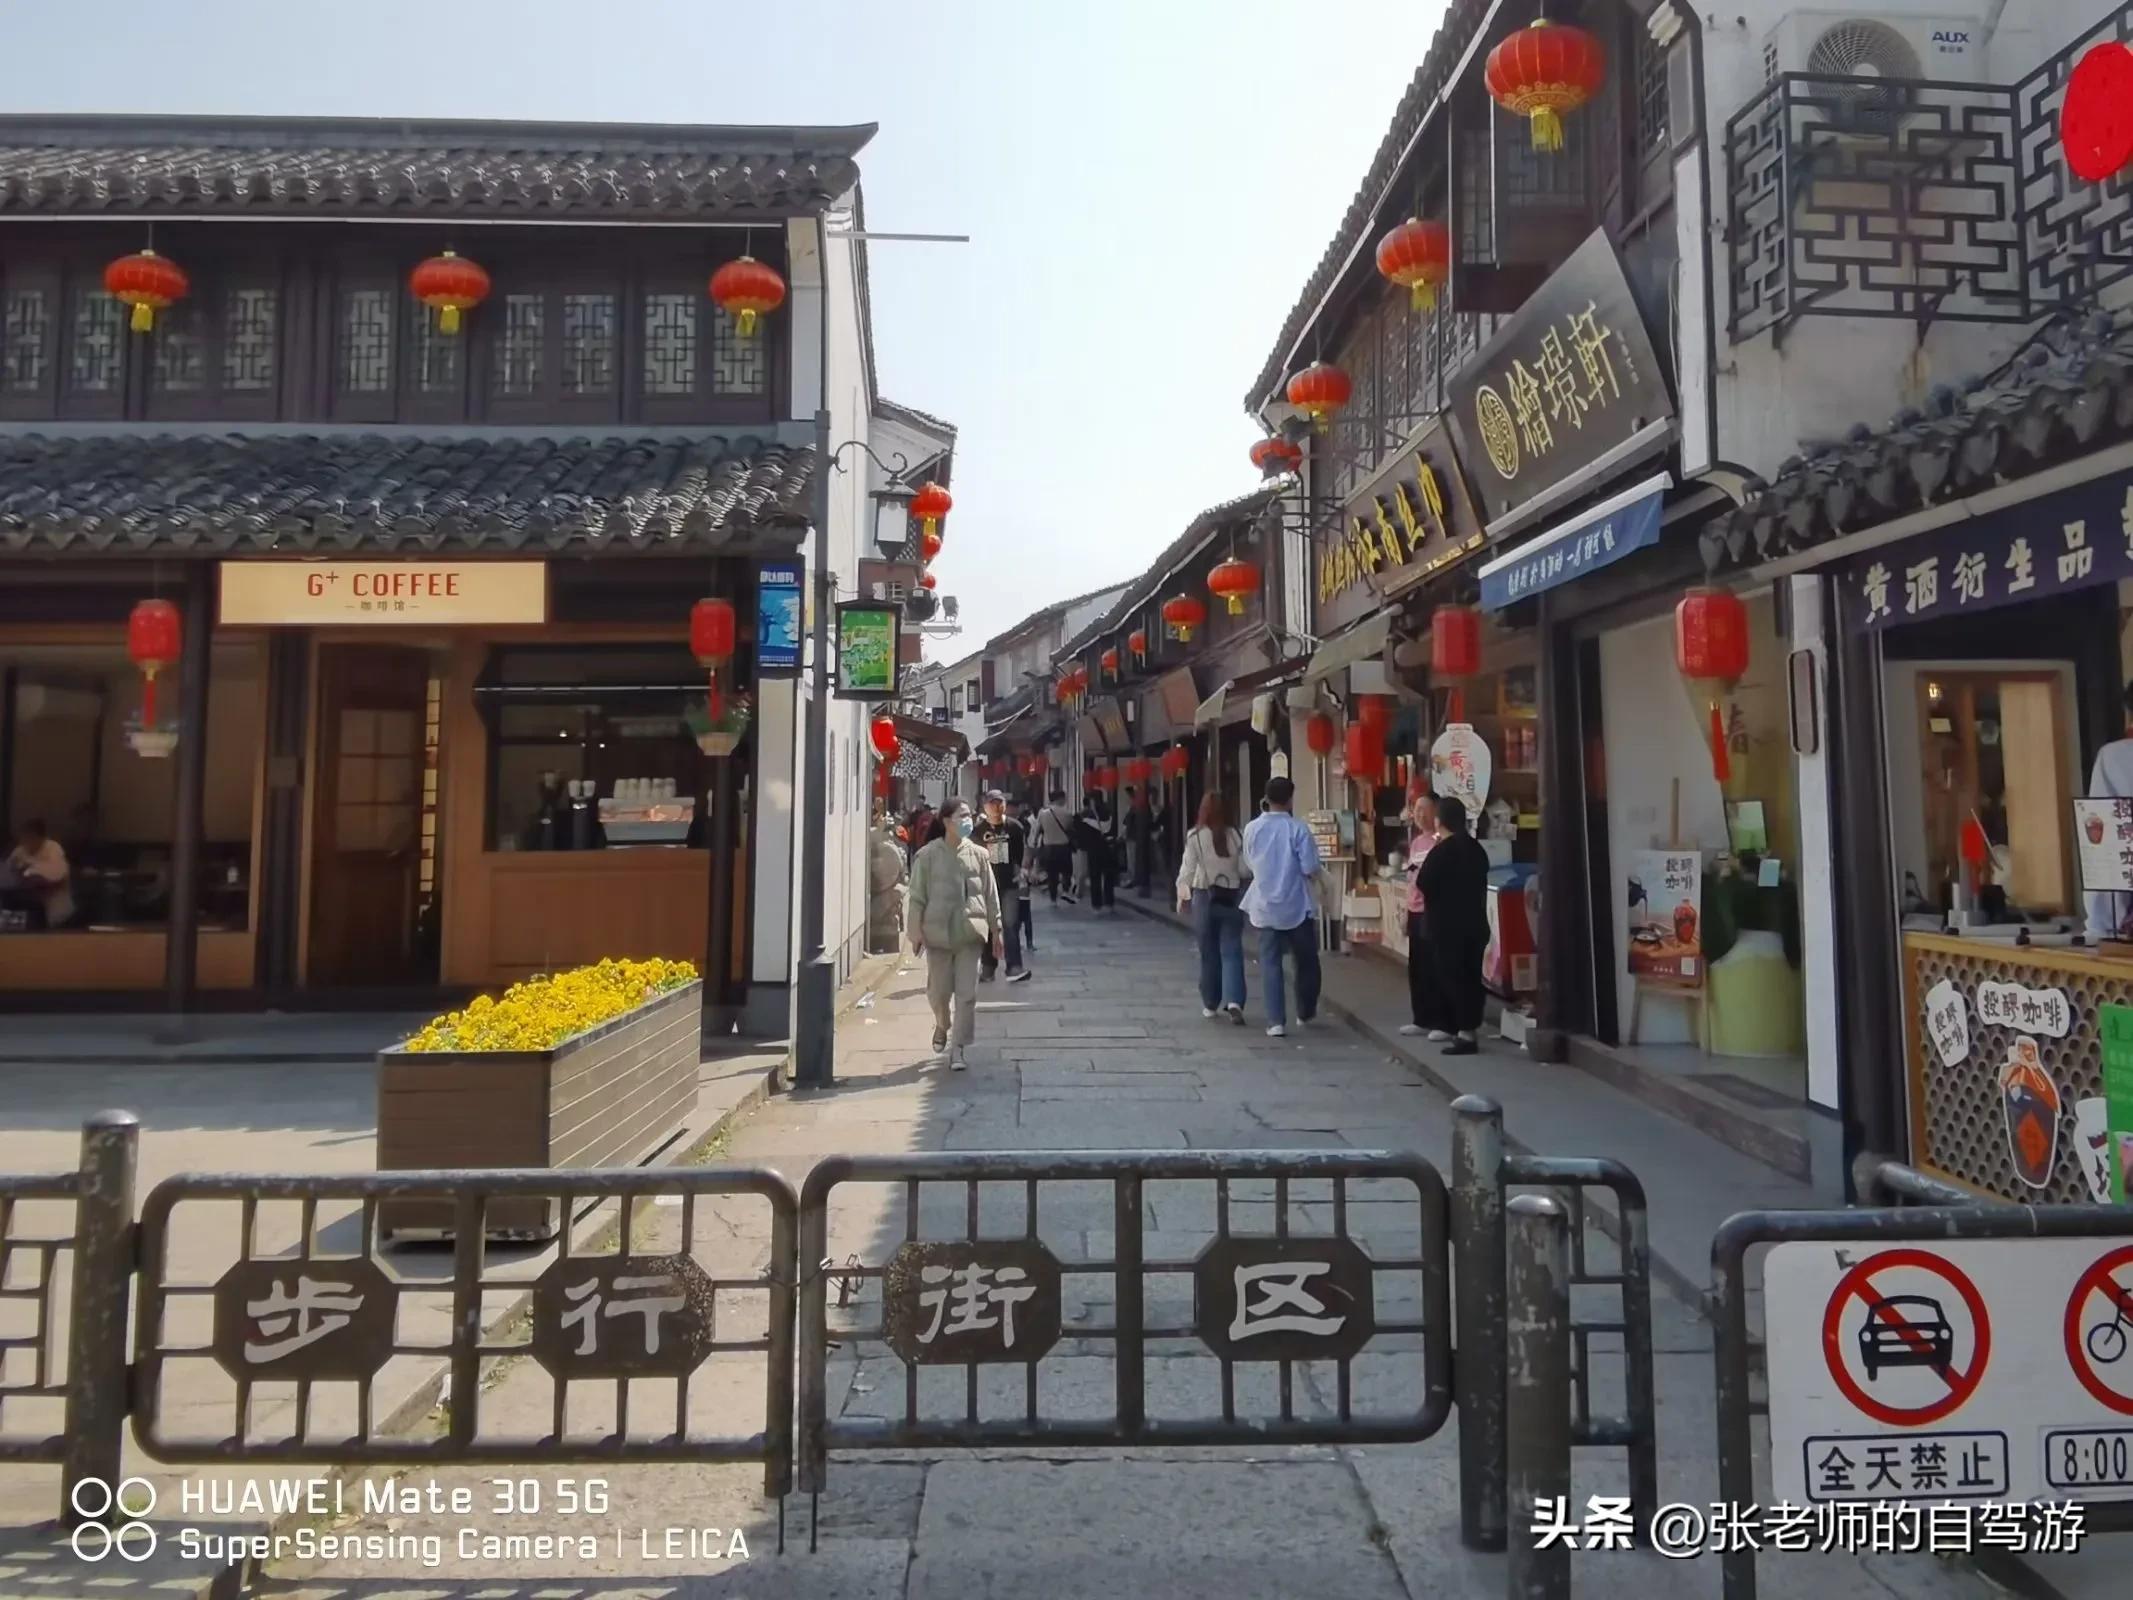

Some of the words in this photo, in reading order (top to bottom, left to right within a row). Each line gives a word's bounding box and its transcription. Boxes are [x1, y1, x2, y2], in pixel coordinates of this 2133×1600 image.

[1931, 31, 1969, 43] AUX
[1864, 484, 2133, 623] 黄酒衍生品
[353, 573, 461, 597] COFFEE
[1817, 1440, 1995, 1493] 全天禁止
